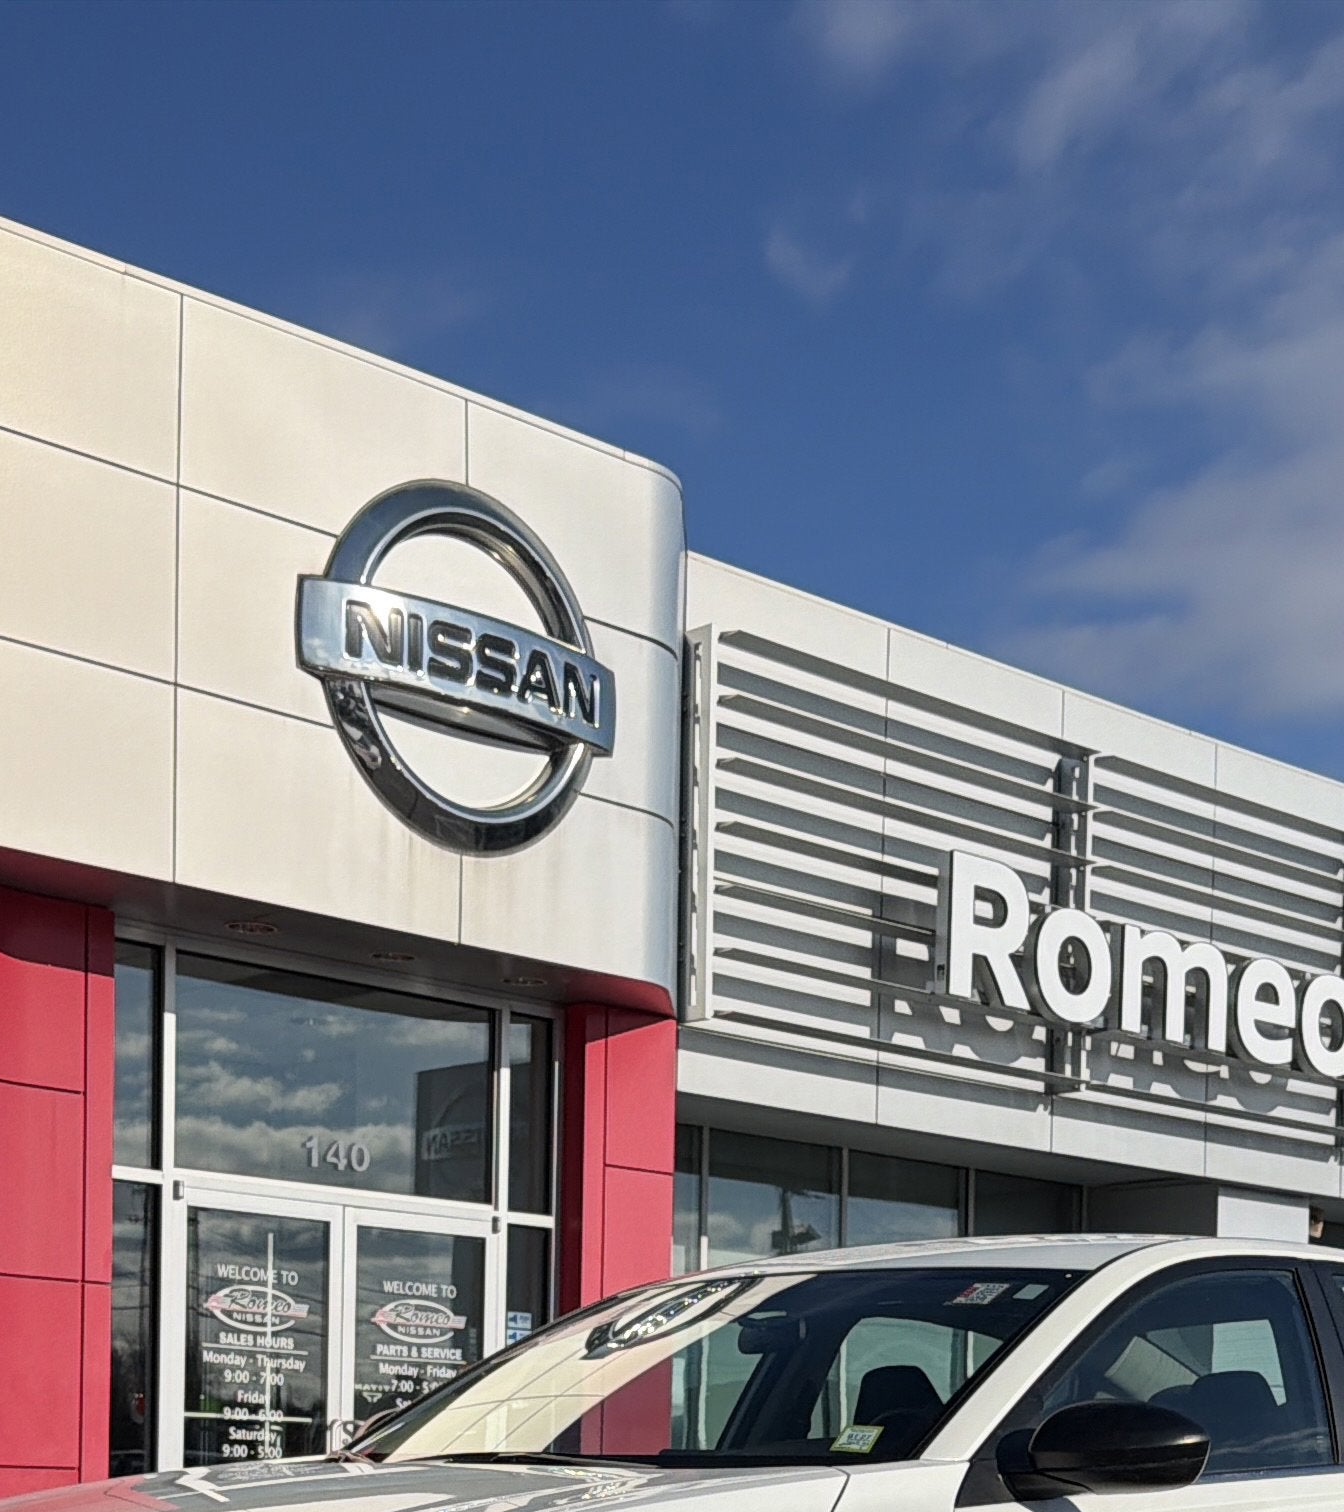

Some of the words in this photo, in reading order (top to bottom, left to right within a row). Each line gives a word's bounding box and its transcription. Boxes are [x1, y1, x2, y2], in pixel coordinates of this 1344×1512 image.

[343, 599, 601, 729] NISSAN
[305, 1135, 371, 1172] 140
[217, 1264, 278, 1284] WELCOME
[280, 1270, 298, 1286] TO
[383, 1280, 438, 1298] WELCOME
[440, 1285, 457, 1299] TO
[233, 1312, 280, 1325] NISSAN
[389, 1302, 451, 1325] Romeo
[398, 1326, 441, 1337] NISSAN
[219, 1332, 254, 1346] SALES
[256, 1335, 295, 1350] HOURS
[203, 1350, 247, 1368] Monday
[256, 1353, 306, 1372] Thursday
[376, 1344, 409, 1358] PARTS
[411, 1346, 419, 1358] &
[421, 1347, 463, 1361] SERVICE
[224, 1369, 250, 1383] 9:00
[259, 1371, 285, 1386] 700
[379, 1362, 419, 1378] Monday
[391, 1379, 415, 1393] 7:00
[237, 1390, 271, 1405] Frida
[223, 1407, 249, 1420] 9:00
[258, 1409, 284, 1422] 600
[229, 1426, 277, 1444] Saturdy
[222, 1443, 249, 1458] 9:00
